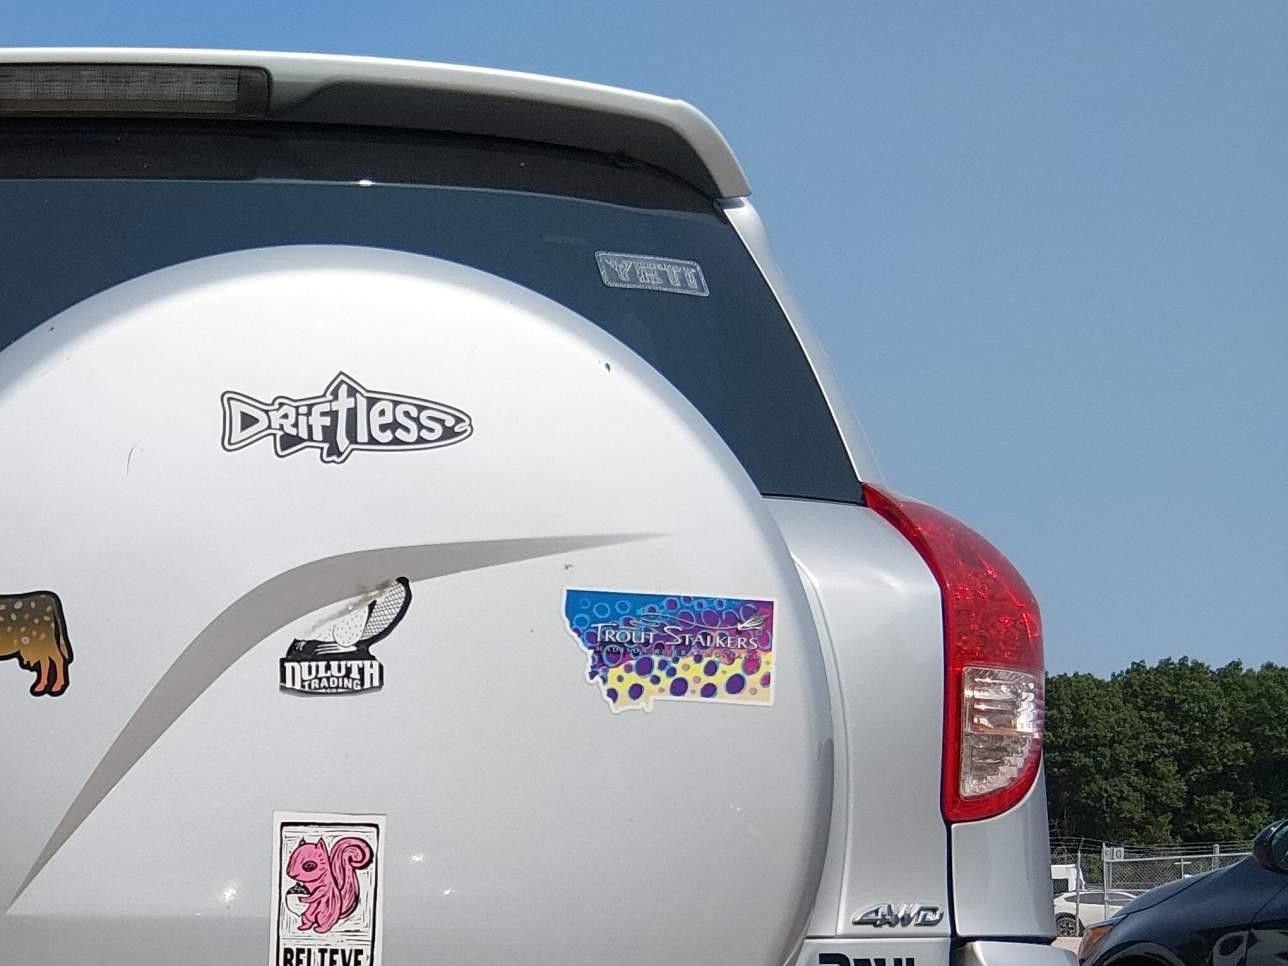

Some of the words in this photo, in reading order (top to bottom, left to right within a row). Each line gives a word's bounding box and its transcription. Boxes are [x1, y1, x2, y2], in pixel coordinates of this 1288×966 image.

[604, 258, 699, 289] YETI
[590, 623, 657, 645] TROUT
[663, 625, 759, 650] STALKERS
[283, 660, 380, 690] DULUTH
[302, 677, 362, 691] TRADING
[851, 903, 945, 928] 4WD
